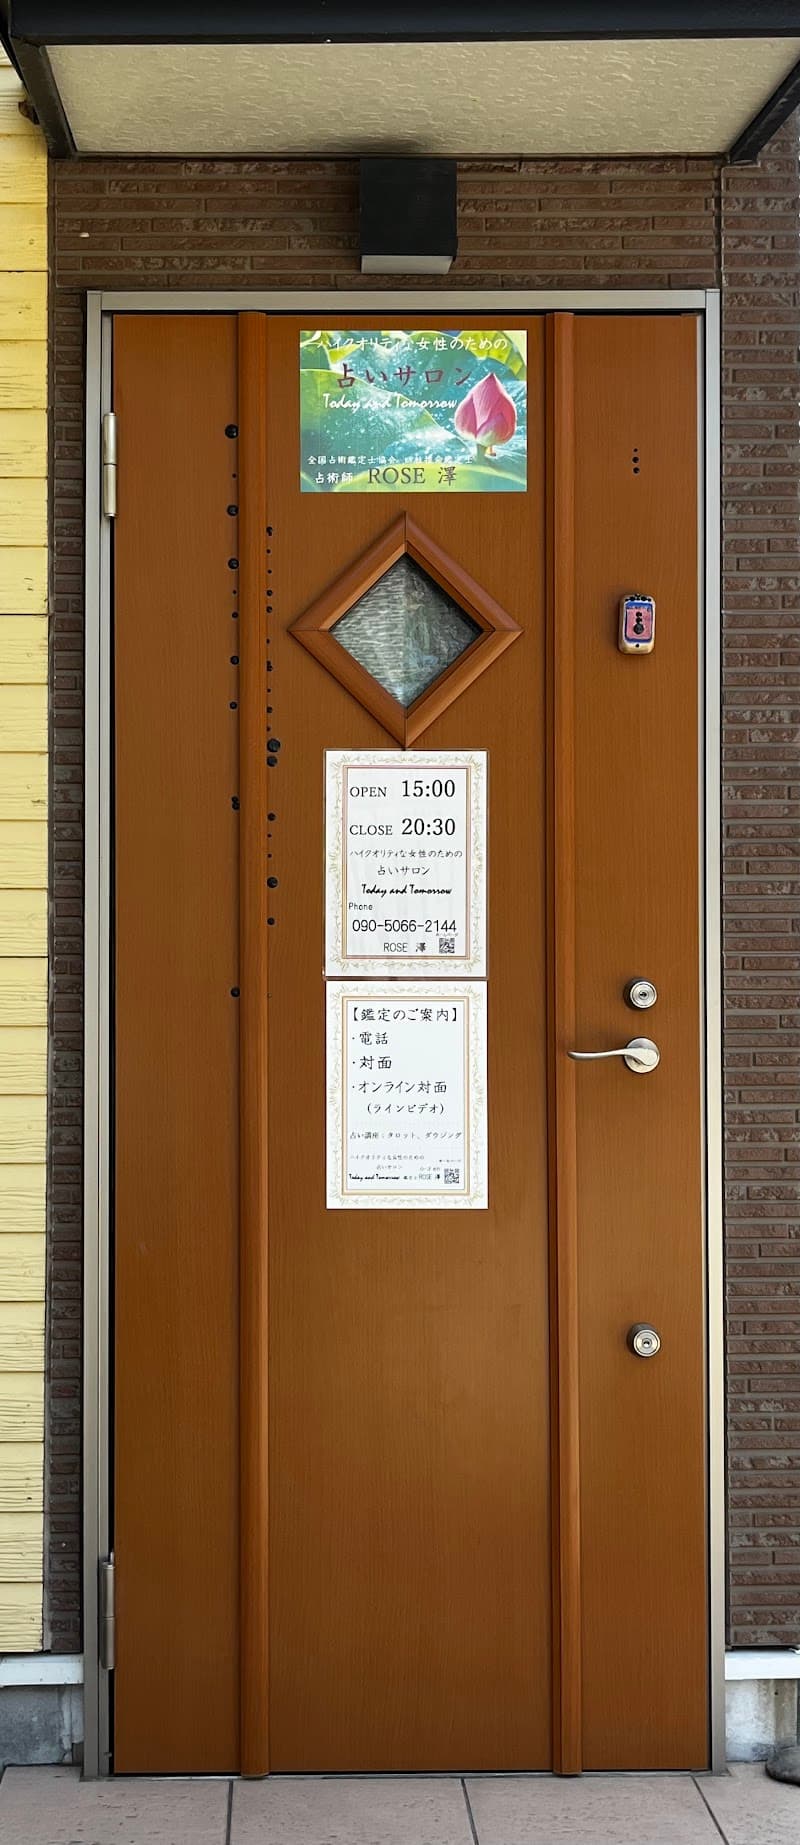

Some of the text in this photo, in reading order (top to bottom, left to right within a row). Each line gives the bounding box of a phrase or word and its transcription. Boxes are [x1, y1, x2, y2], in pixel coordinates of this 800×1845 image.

[337, 363, 471, 389] 占いサロン
[323, 393, 459, 414] Today and Tomorrow
[315, 467, 457, 486] 占術師 ROSE 澤
[350, 780, 456, 798] OPEN 15:00
[350, 818, 456, 836] CLOSE 20:30
[350, 849, 463, 858] ハイクオリティな女性のための
[377, 865, 431, 876] 占いサロン
[361, 884, 452, 898] Today and Tomorrow
[348, 902, 373, 911] Phone
[352, 919, 457, 933] 090-5066-2144
[383, 942, 408, 953] ROSE
[352, 1007, 458, 1022] 【鑑定のご案内】
